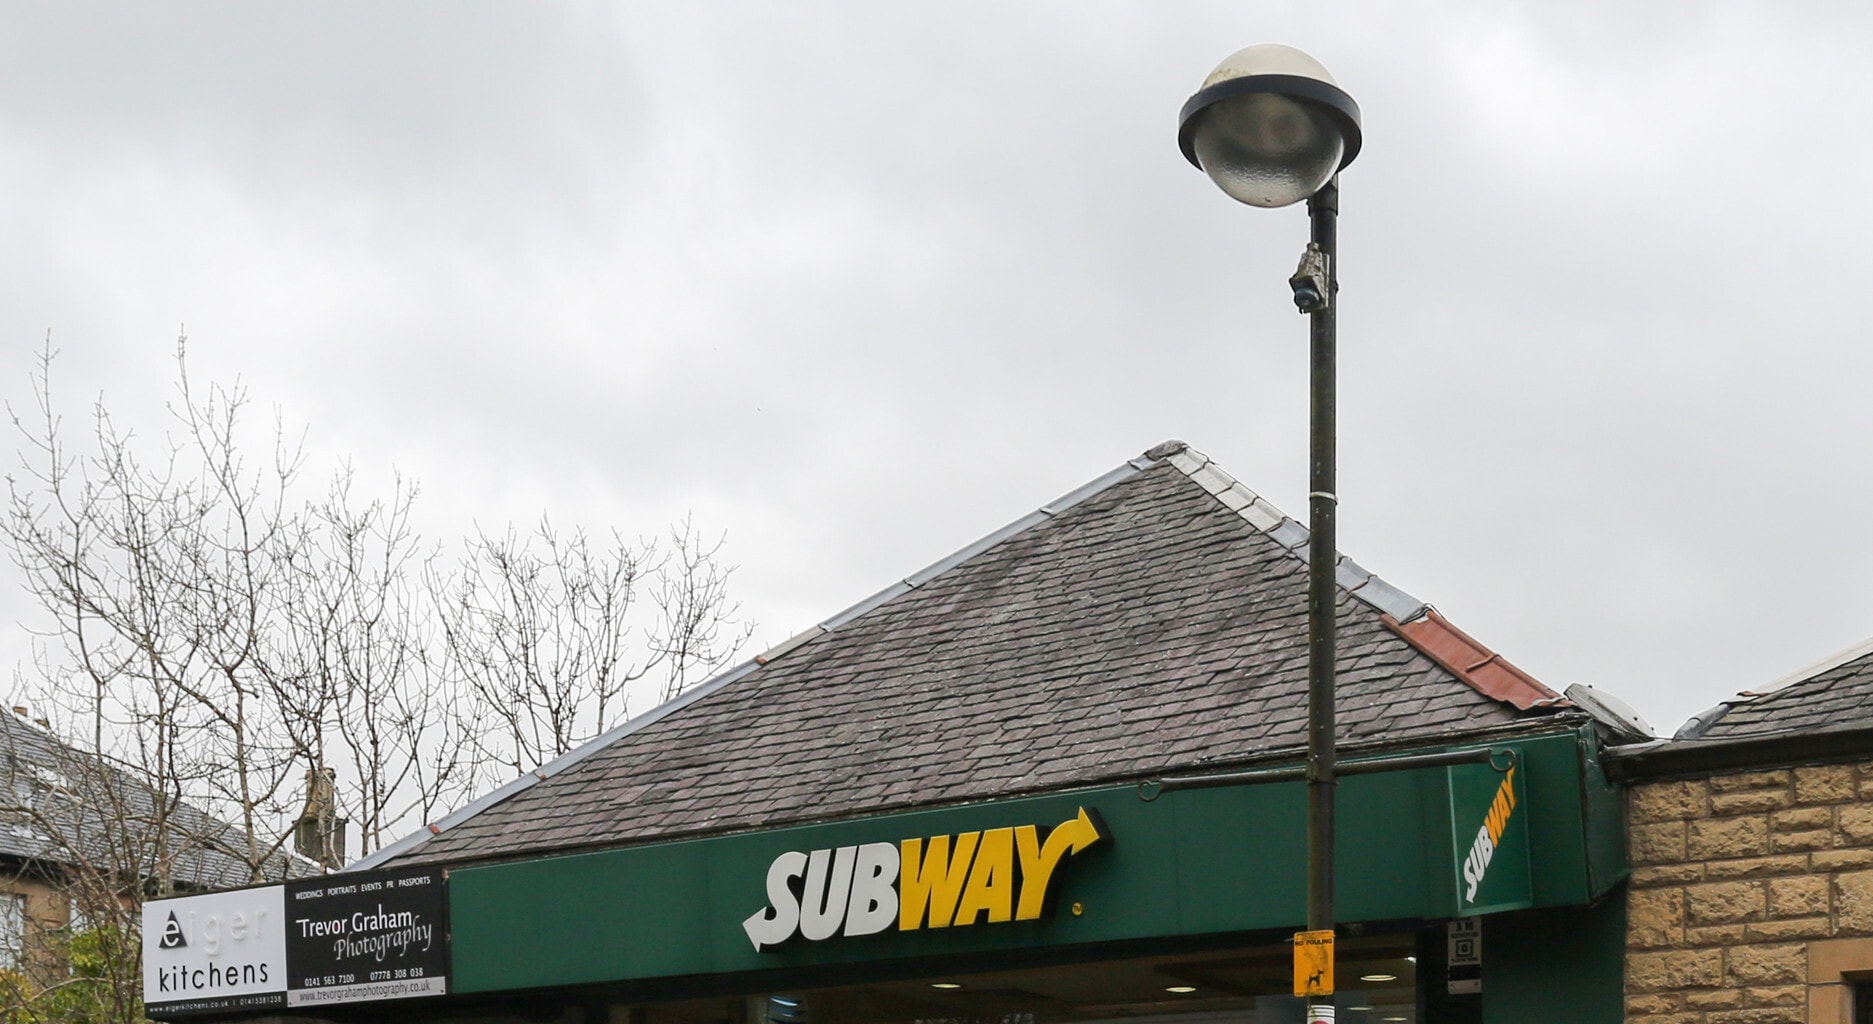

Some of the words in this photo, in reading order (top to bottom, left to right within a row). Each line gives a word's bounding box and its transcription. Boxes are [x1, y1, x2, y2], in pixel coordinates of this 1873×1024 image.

[1464, 767, 1517, 903] SUBWAY
[295, 889, 323, 900] WEDDINGS
[327, 885, 357, 896] PORTRAITS
[361, 882, 382, 892] EVENTS
[386, 880, 394, 889] PR
[398, 876, 431, 887] PASSPORTS
[742, 806, 1100, 952] SUBWAY
[160, 909, 266, 956] eiger
[296, 918, 348, 938] Trevor
[352, 903, 412, 933] Graham
[333, 915, 432, 962] Photography
[159, 961, 269, 992] kitchens
[299, 980, 430, 1002] www.trevorgrahamphotography.co.uk
[304, 977, 320, 987] 0141
[324, 976, 335, 985] 563
[338, 974, 355, 984] 7100
[370, 970, 391, 981] 07778
[394, 969, 407, 979] 308
[410, 967, 423, 977] 038
